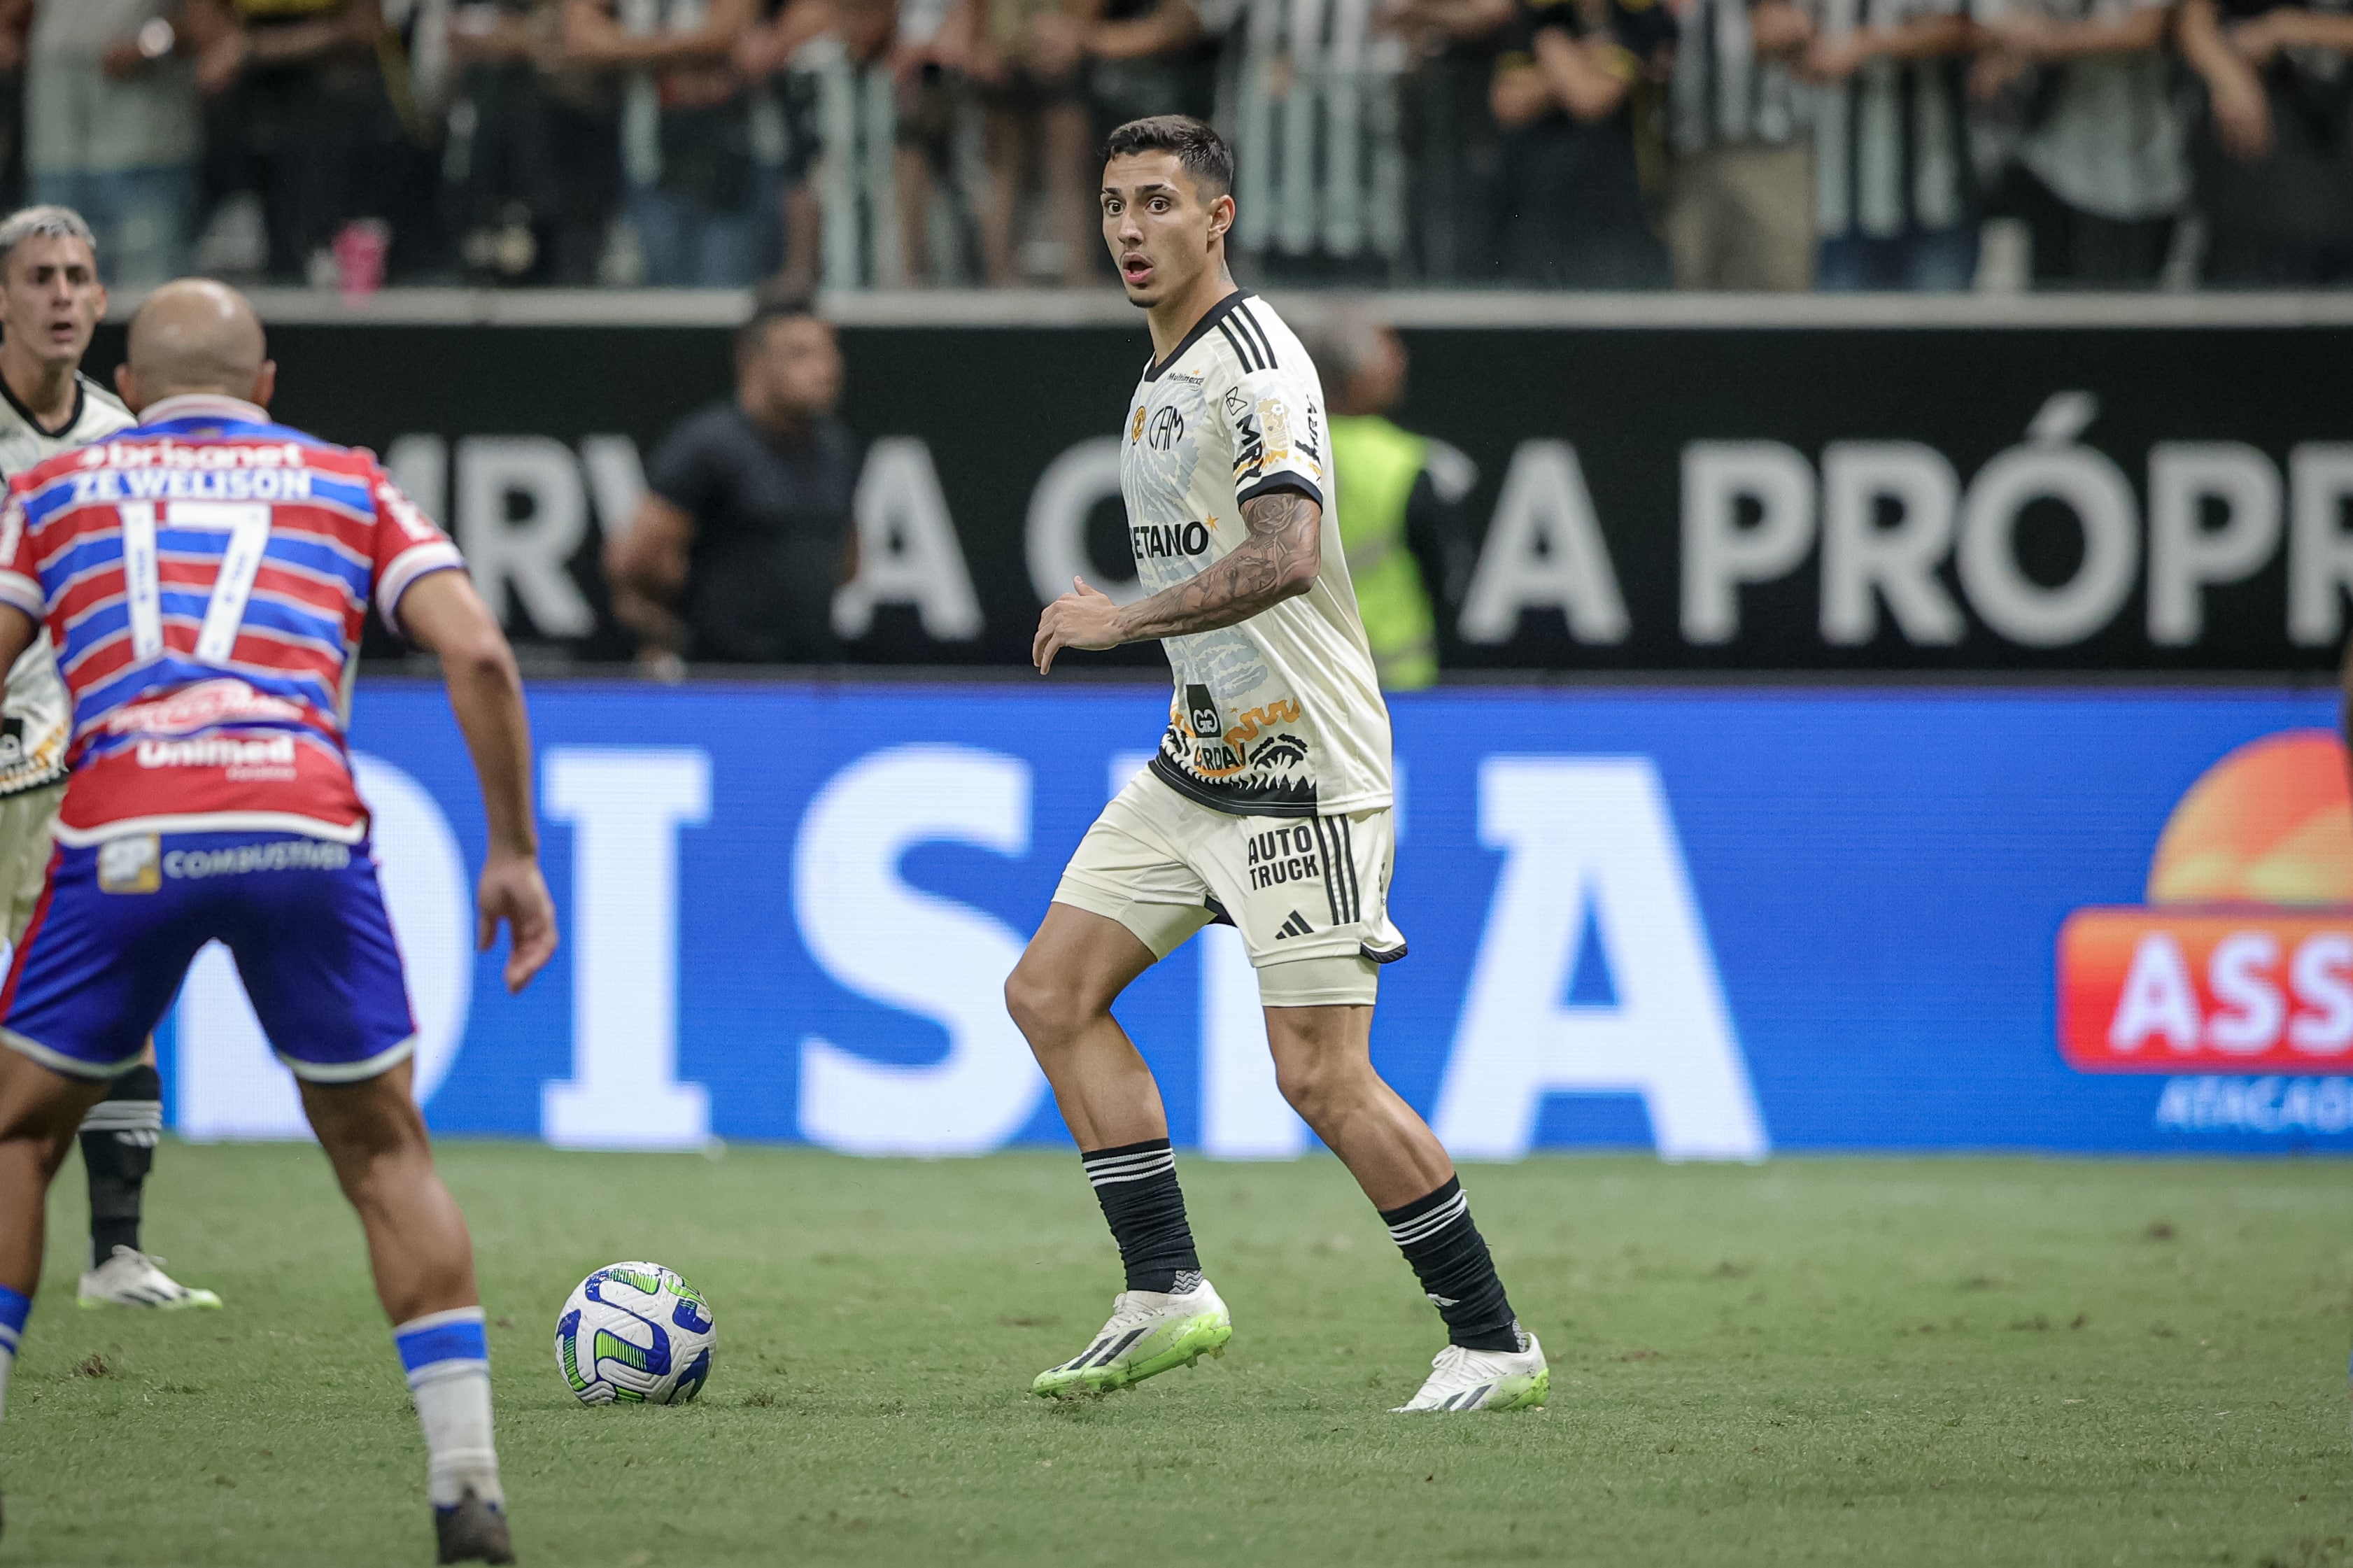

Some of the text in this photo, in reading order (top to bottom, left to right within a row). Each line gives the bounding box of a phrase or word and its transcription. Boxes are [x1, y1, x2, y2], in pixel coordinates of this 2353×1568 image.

[1149, 405, 1184, 451] CAM
[120, 467, 313, 500] WELISON
[1129, 521, 1208, 559] ETANO
[119, 501, 271, 663] 17
[138, 735, 295, 768] Unimed
[1248, 825, 1313, 866] AUTO
[1249, 854, 1320, 891] TRUCK
[2107, 929, 2353, 1054] ASS
